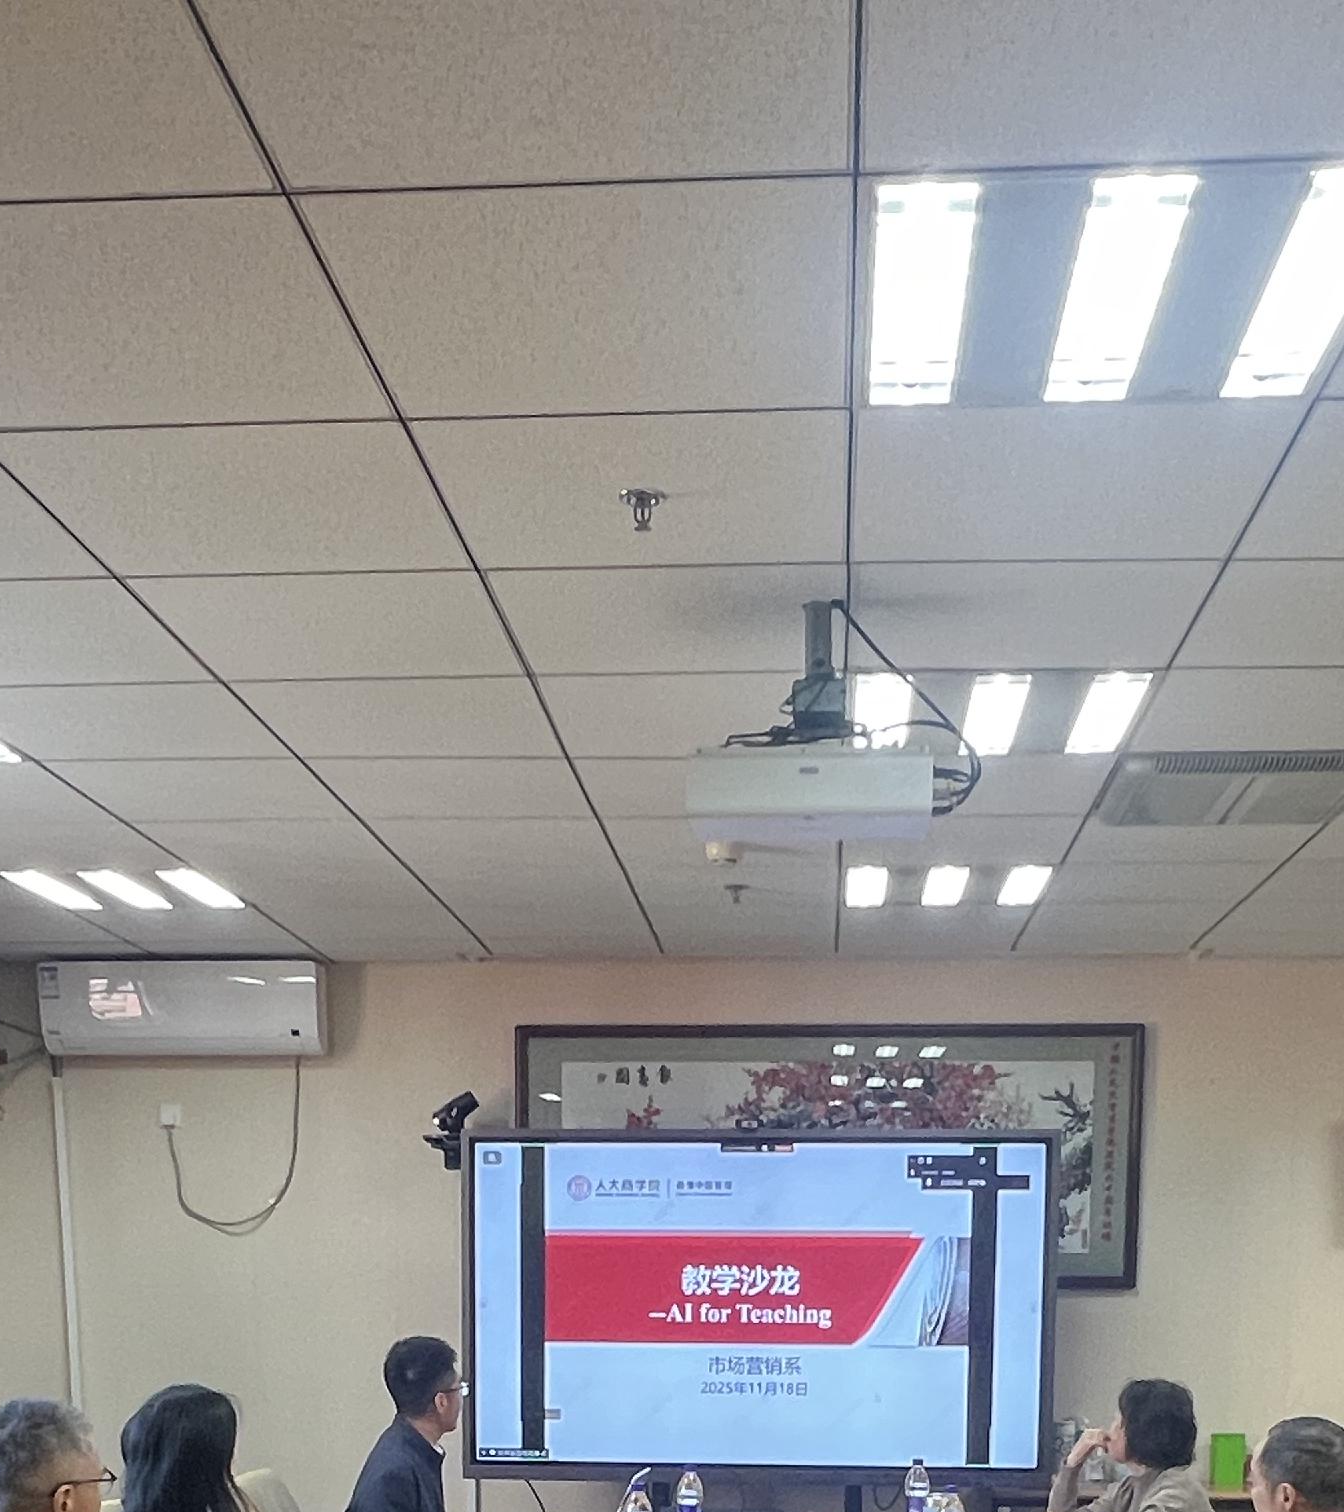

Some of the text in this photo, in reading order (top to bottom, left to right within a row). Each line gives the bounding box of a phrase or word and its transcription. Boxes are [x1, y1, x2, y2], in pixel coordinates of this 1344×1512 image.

[595, 1178, 660, 1192] 人大商学院
[681, 1264, 801, 1296] 教学沙龙
[699, 1303, 732, 1323] for
[735, 1303, 832, 1329] Teaching
[708, 1356, 802, 1376] 市场营销系
[701, 1381, 808, 1396] 2025年11月18日
